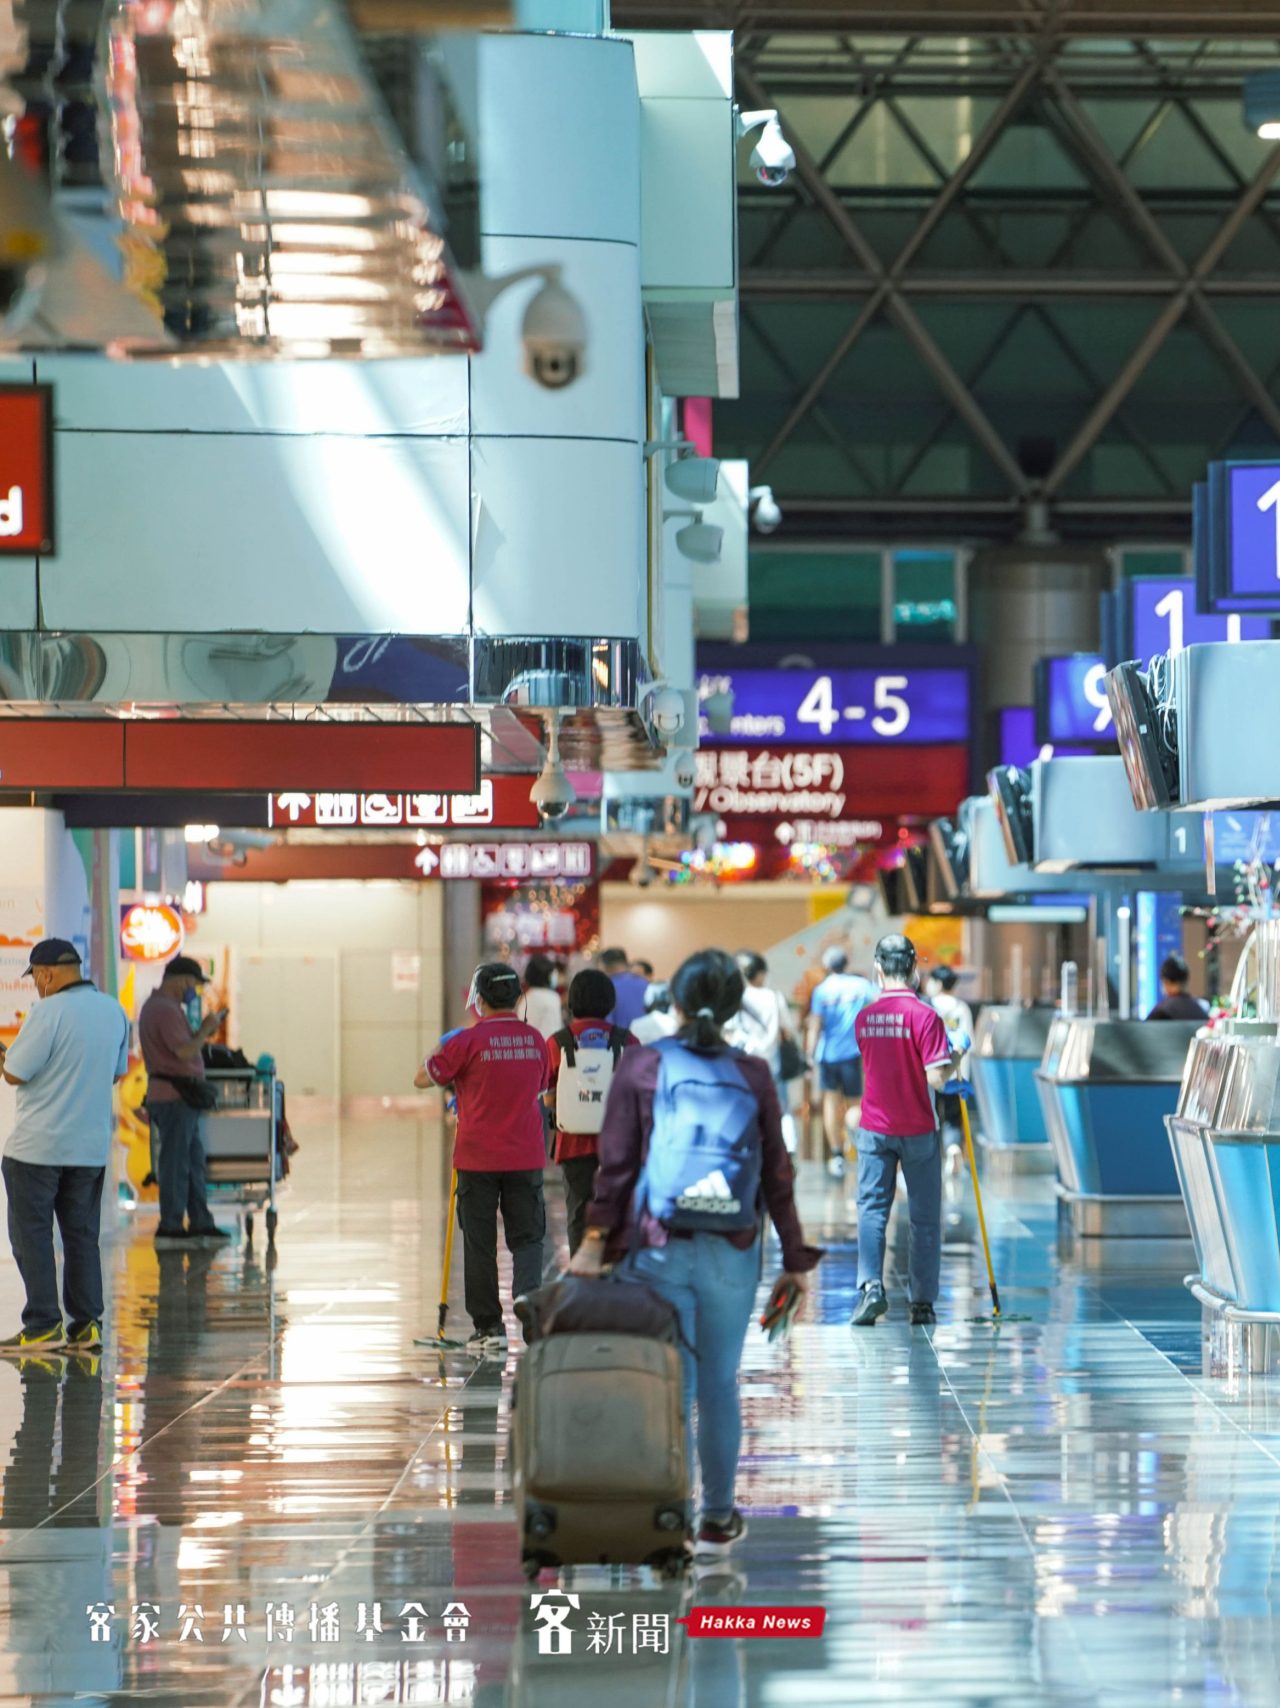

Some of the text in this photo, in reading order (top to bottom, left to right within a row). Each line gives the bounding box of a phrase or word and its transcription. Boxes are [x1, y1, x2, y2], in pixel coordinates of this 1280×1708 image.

[797, 675, 910, 736] 4-5
[709, 787, 846, 818] Observatory
[1174, 827, 1186, 854] 1
